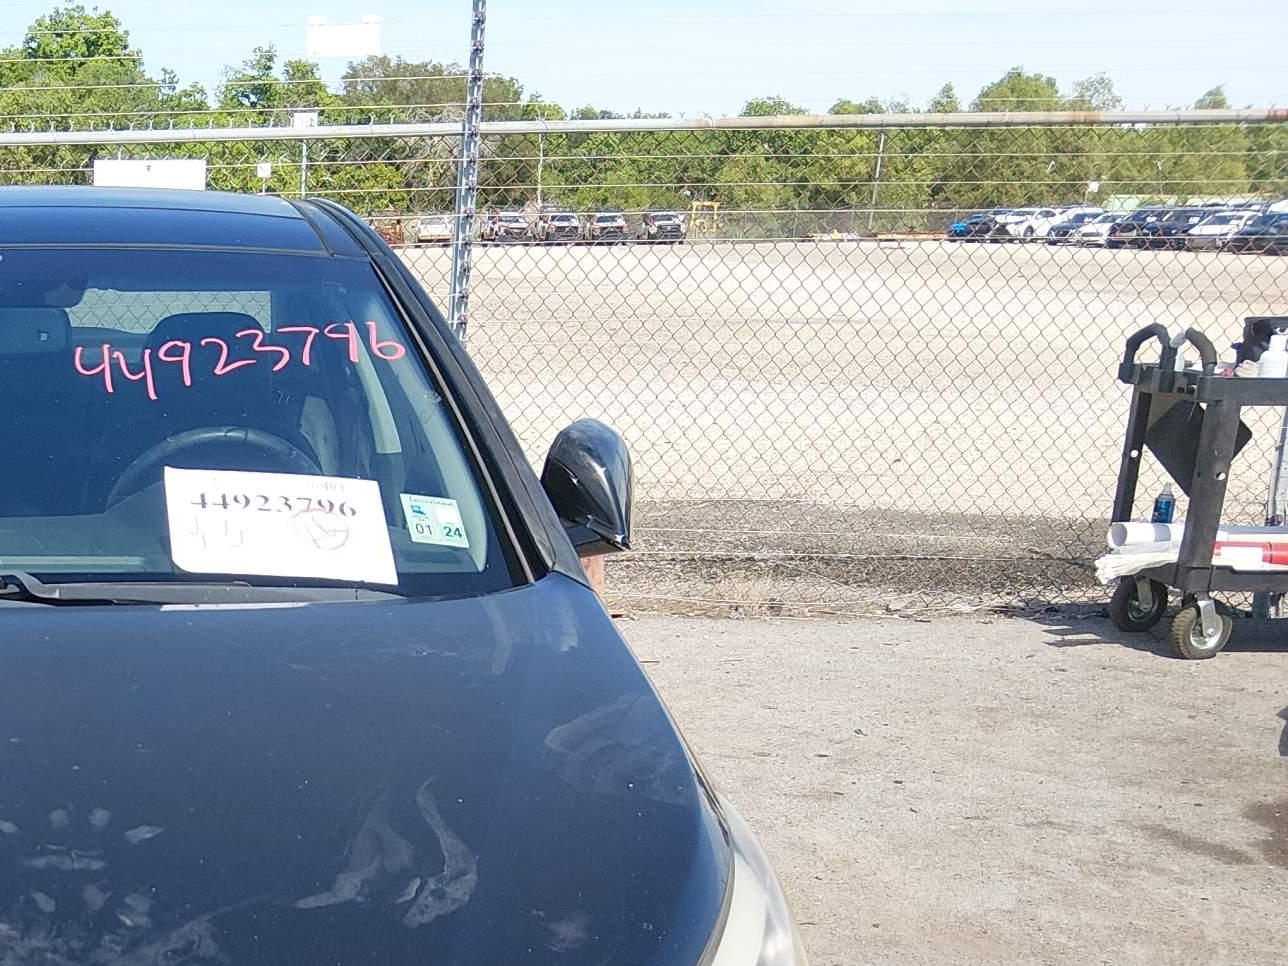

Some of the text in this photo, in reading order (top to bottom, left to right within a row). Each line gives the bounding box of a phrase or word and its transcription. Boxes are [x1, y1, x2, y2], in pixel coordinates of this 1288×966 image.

[73, 320, 407, 400] 44923796
[190, 492, 358, 518] 44923796
[415, 523, 463, 538] 01 24
